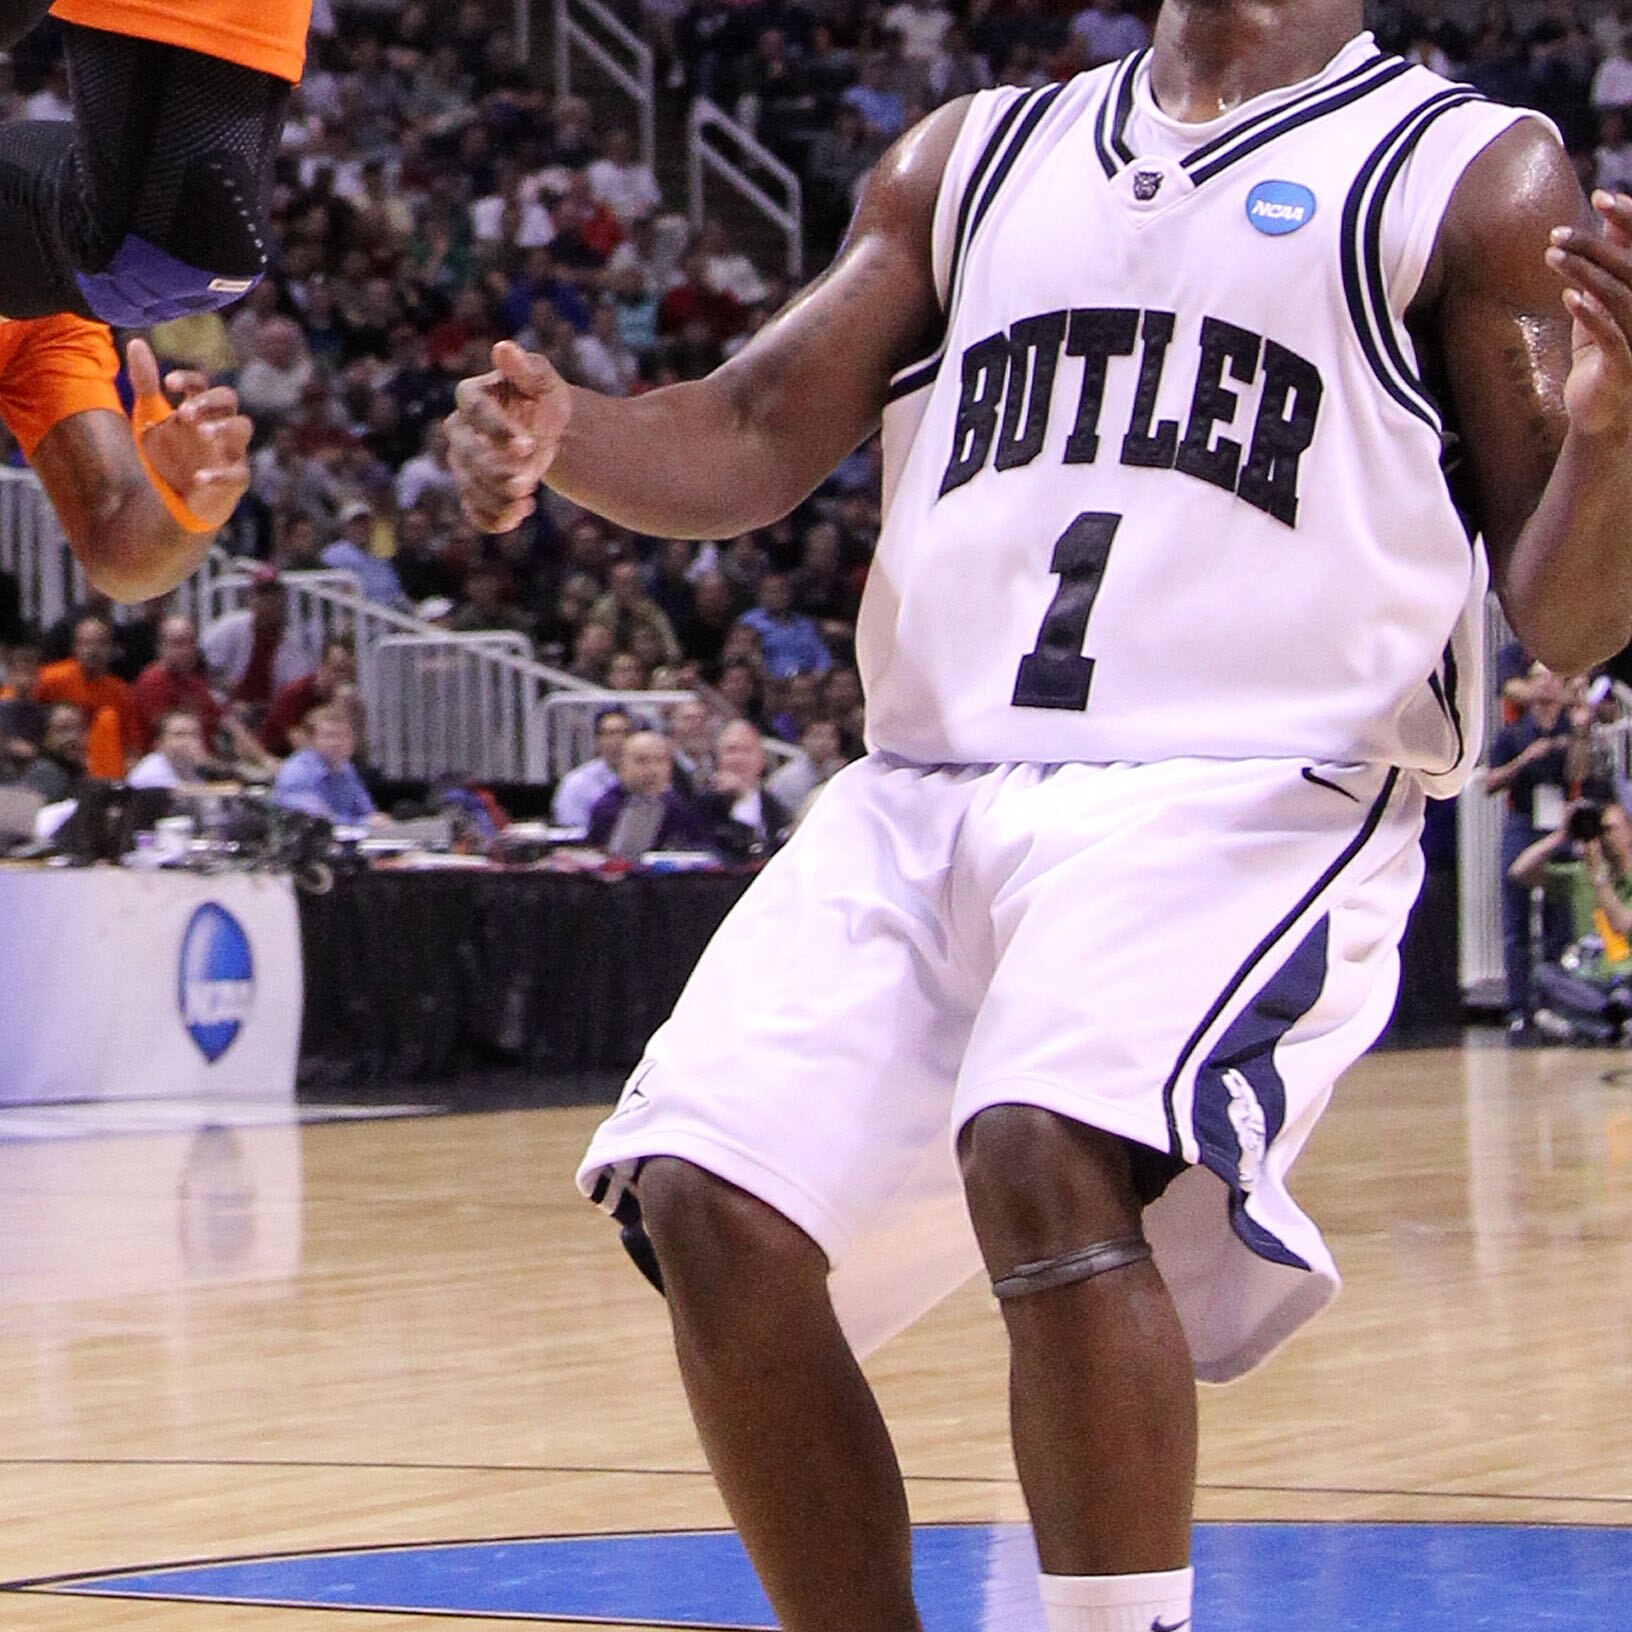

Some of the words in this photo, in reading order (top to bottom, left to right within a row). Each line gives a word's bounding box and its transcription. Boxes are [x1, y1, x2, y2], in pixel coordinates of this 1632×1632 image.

[1251, 199, 1305, 221] NCAA
[933, 307, 1324, 530] BUTLER
[1010, 511, 1124, 711] 1
